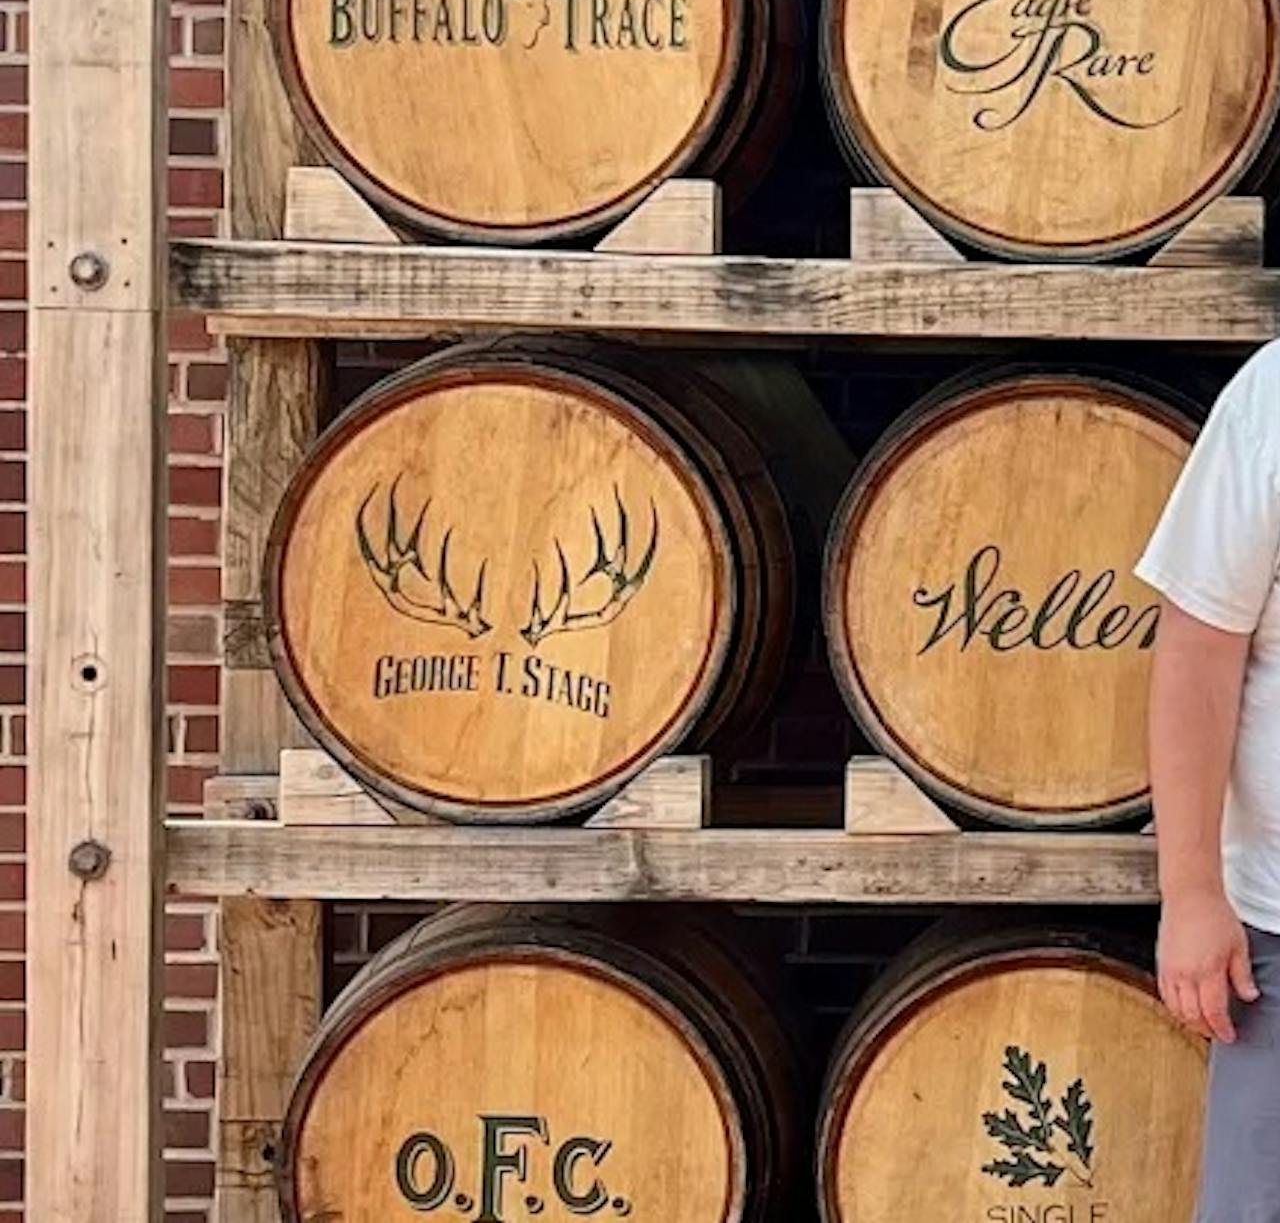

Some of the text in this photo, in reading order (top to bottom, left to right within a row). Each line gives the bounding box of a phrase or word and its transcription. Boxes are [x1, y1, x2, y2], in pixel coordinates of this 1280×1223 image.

[972, 21, 1182, 132] Rare
[374, 652, 612, 719] GEORGE T. STAGG
